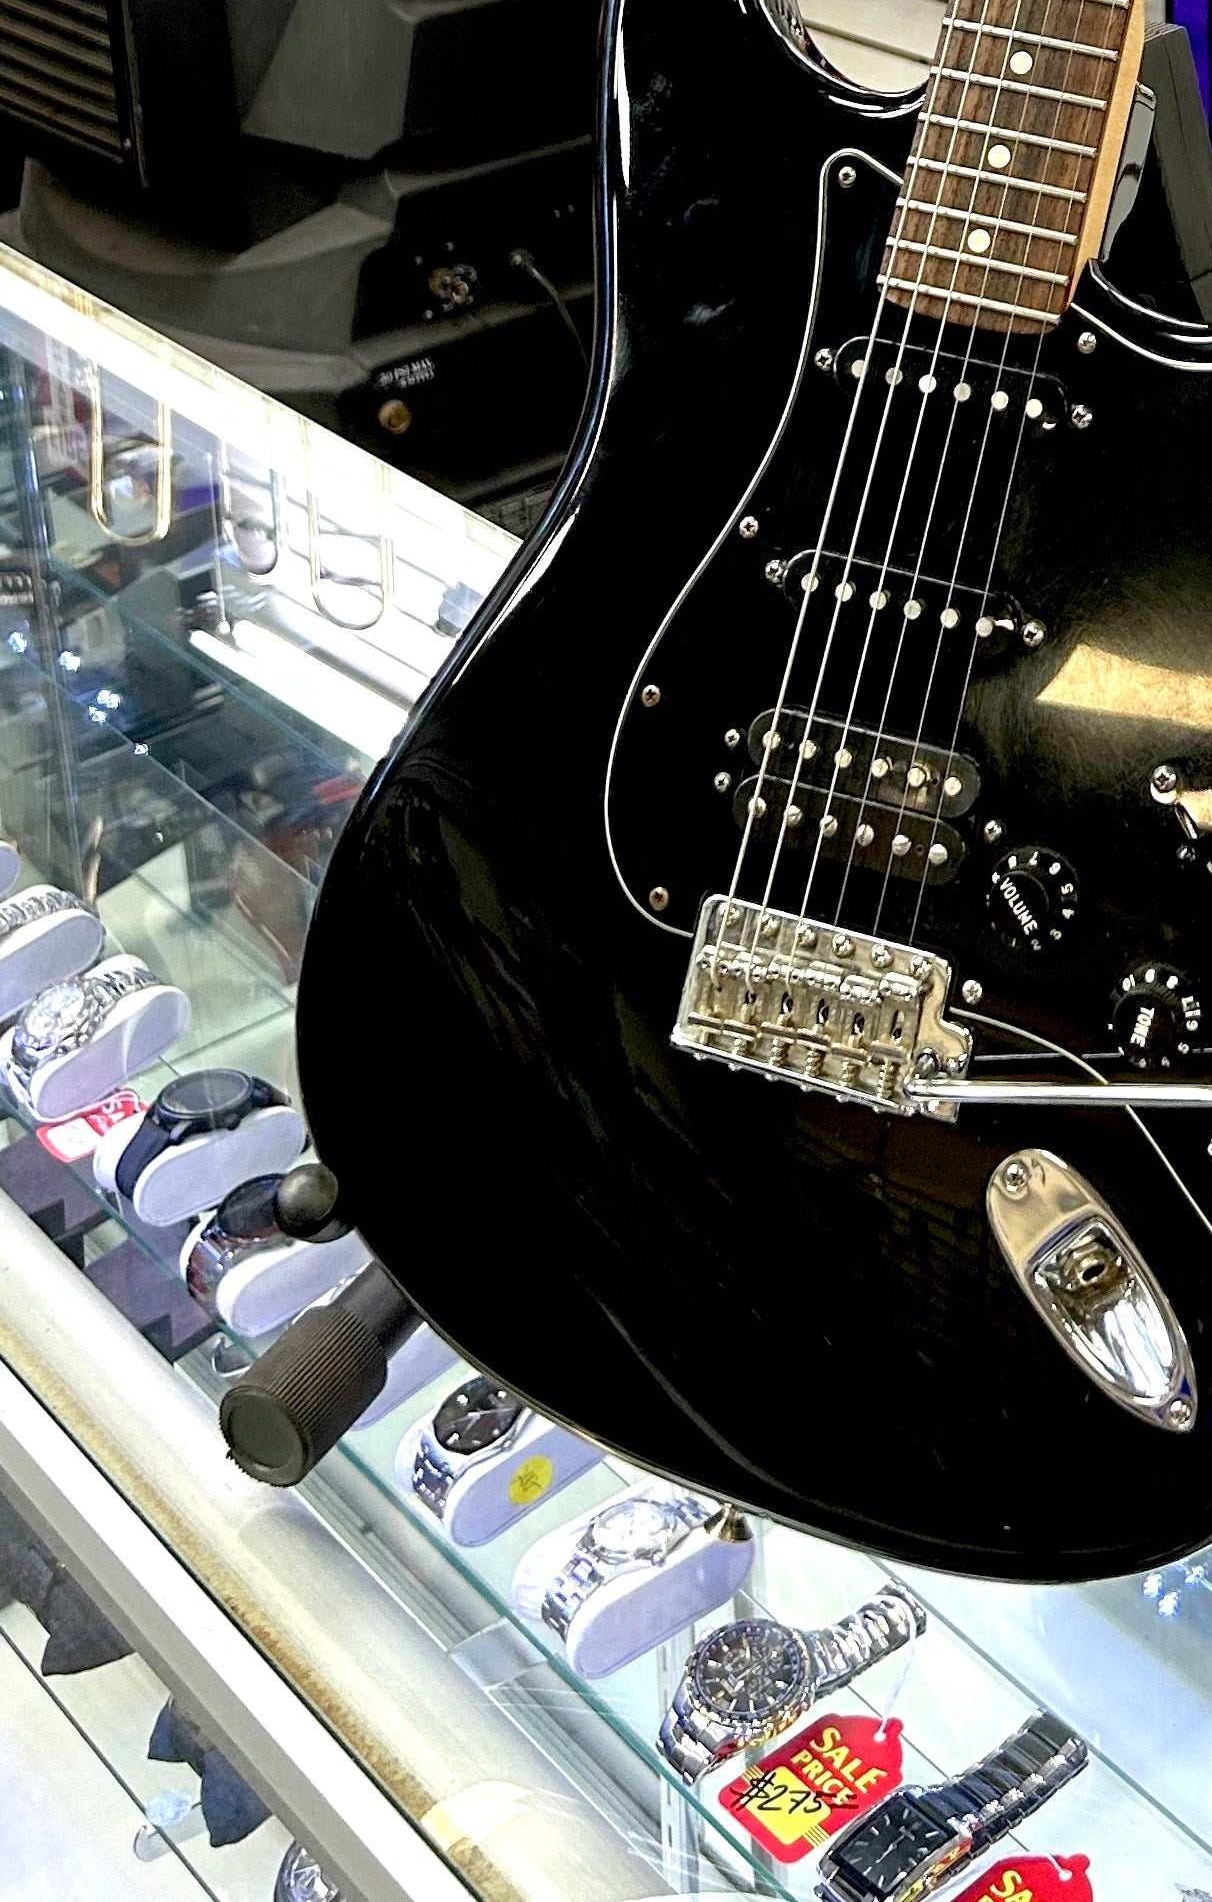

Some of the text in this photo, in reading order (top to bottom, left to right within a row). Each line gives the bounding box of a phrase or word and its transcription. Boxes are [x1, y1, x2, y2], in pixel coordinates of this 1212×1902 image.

[1000, 877, 1039, 935] VOLUME
[1130, 1007, 1155, 1048] TONE
[791, 1749, 855, 1805] PRICE
[810, 1727, 887, 1793] SALE
